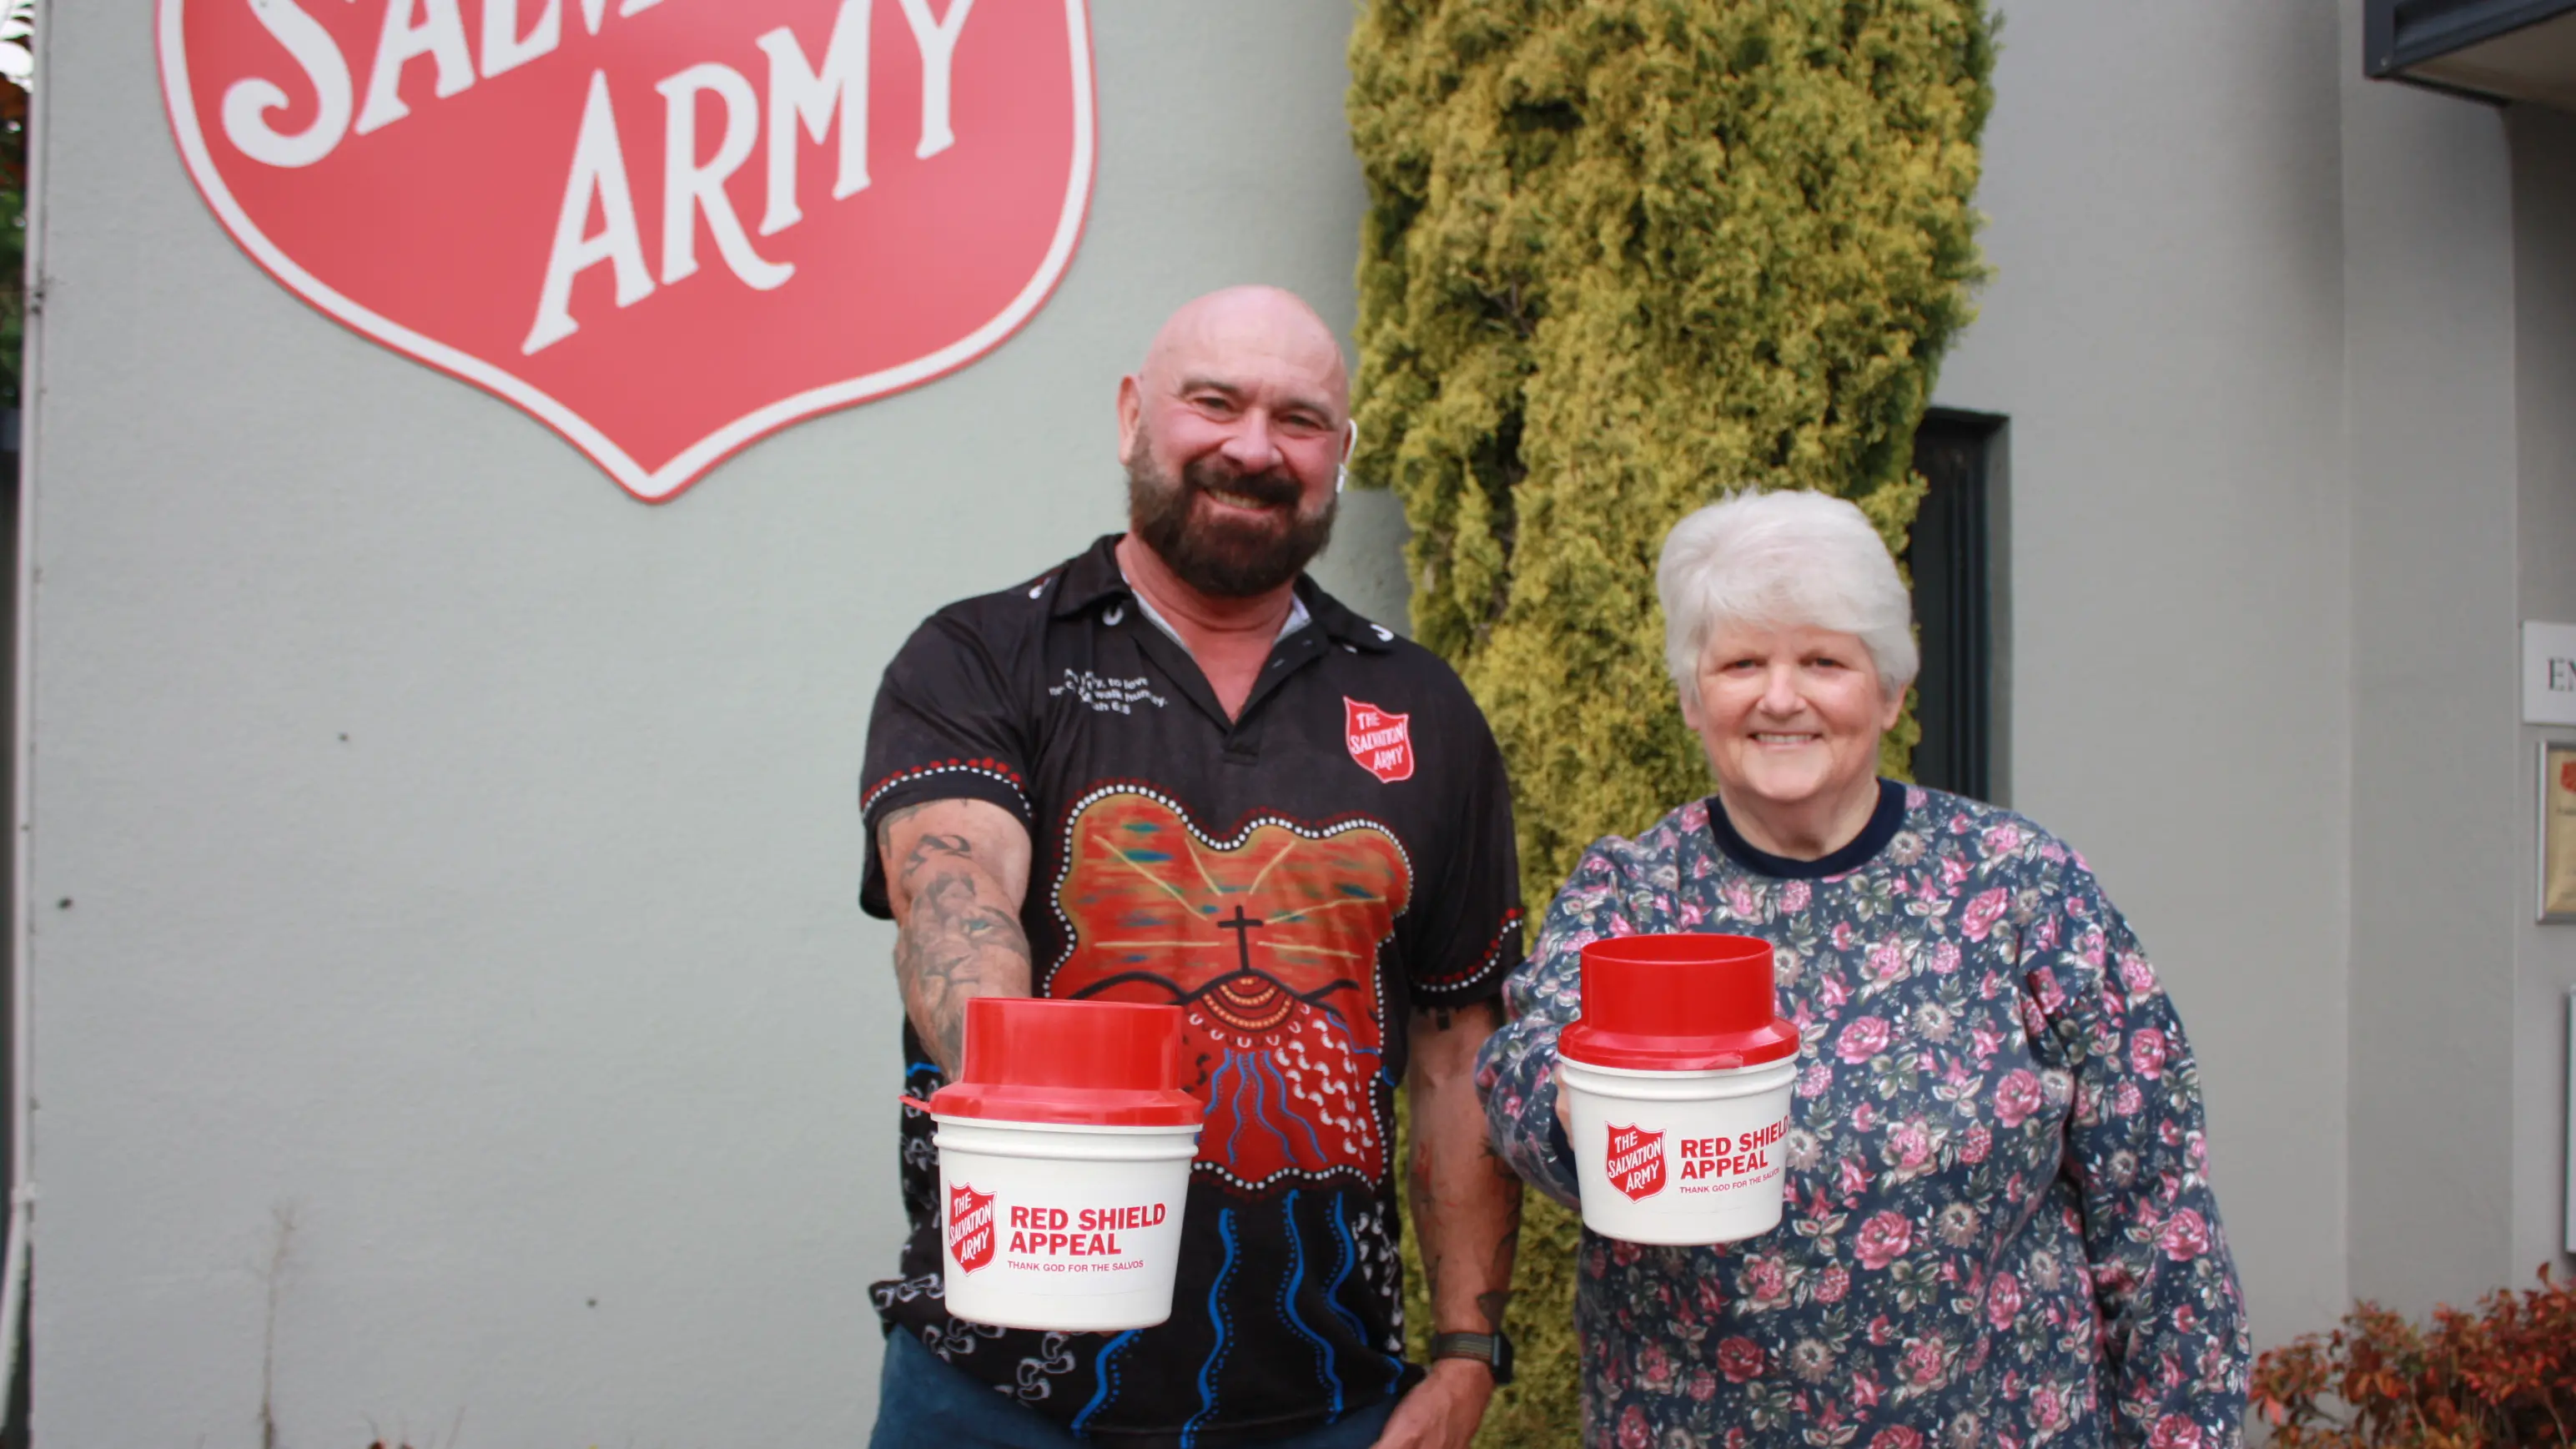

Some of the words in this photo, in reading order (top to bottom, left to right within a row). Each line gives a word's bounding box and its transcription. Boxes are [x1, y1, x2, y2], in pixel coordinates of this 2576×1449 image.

[521, 0, 974, 355] ARMY
[1373, 745, 1404, 771] ARMY
[1615, 1130, 1638, 1153] THE
[1680, 1137, 1732, 1159] RED
[1738, 1114, 1789, 1153] SHIELD
[1607, 1136, 1662, 1179] SALVATION
[1680, 1150, 1768, 1180] APPEAL
[1625, 1160, 1659, 1193] ARMY
[1679, 1185, 1709, 1194] THANK
[1712, 1183, 1730, 1192] GOD
[1732, 1180, 1748, 1190] FOR
[1748, 1175, 1762, 1185] THE
[953, 1191, 972, 1218] THE
[1010, 1205, 1069, 1230] RED
[1077, 1203, 1166, 1232] SHIELD
[949, 1200, 992, 1247] SALVATION
[960, 1226, 989, 1264] ARMY
[1009, 1230, 1122, 1256] APPEAL
[1008, 1260, 1040, 1271] THANK
[1043, 1264, 1065, 1272] GOD
[1068, 1264, 1089, 1272] FOR
[1091, 1264, 1109, 1272] THE
[1112, 1260, 1145, 1271] SALVOS
